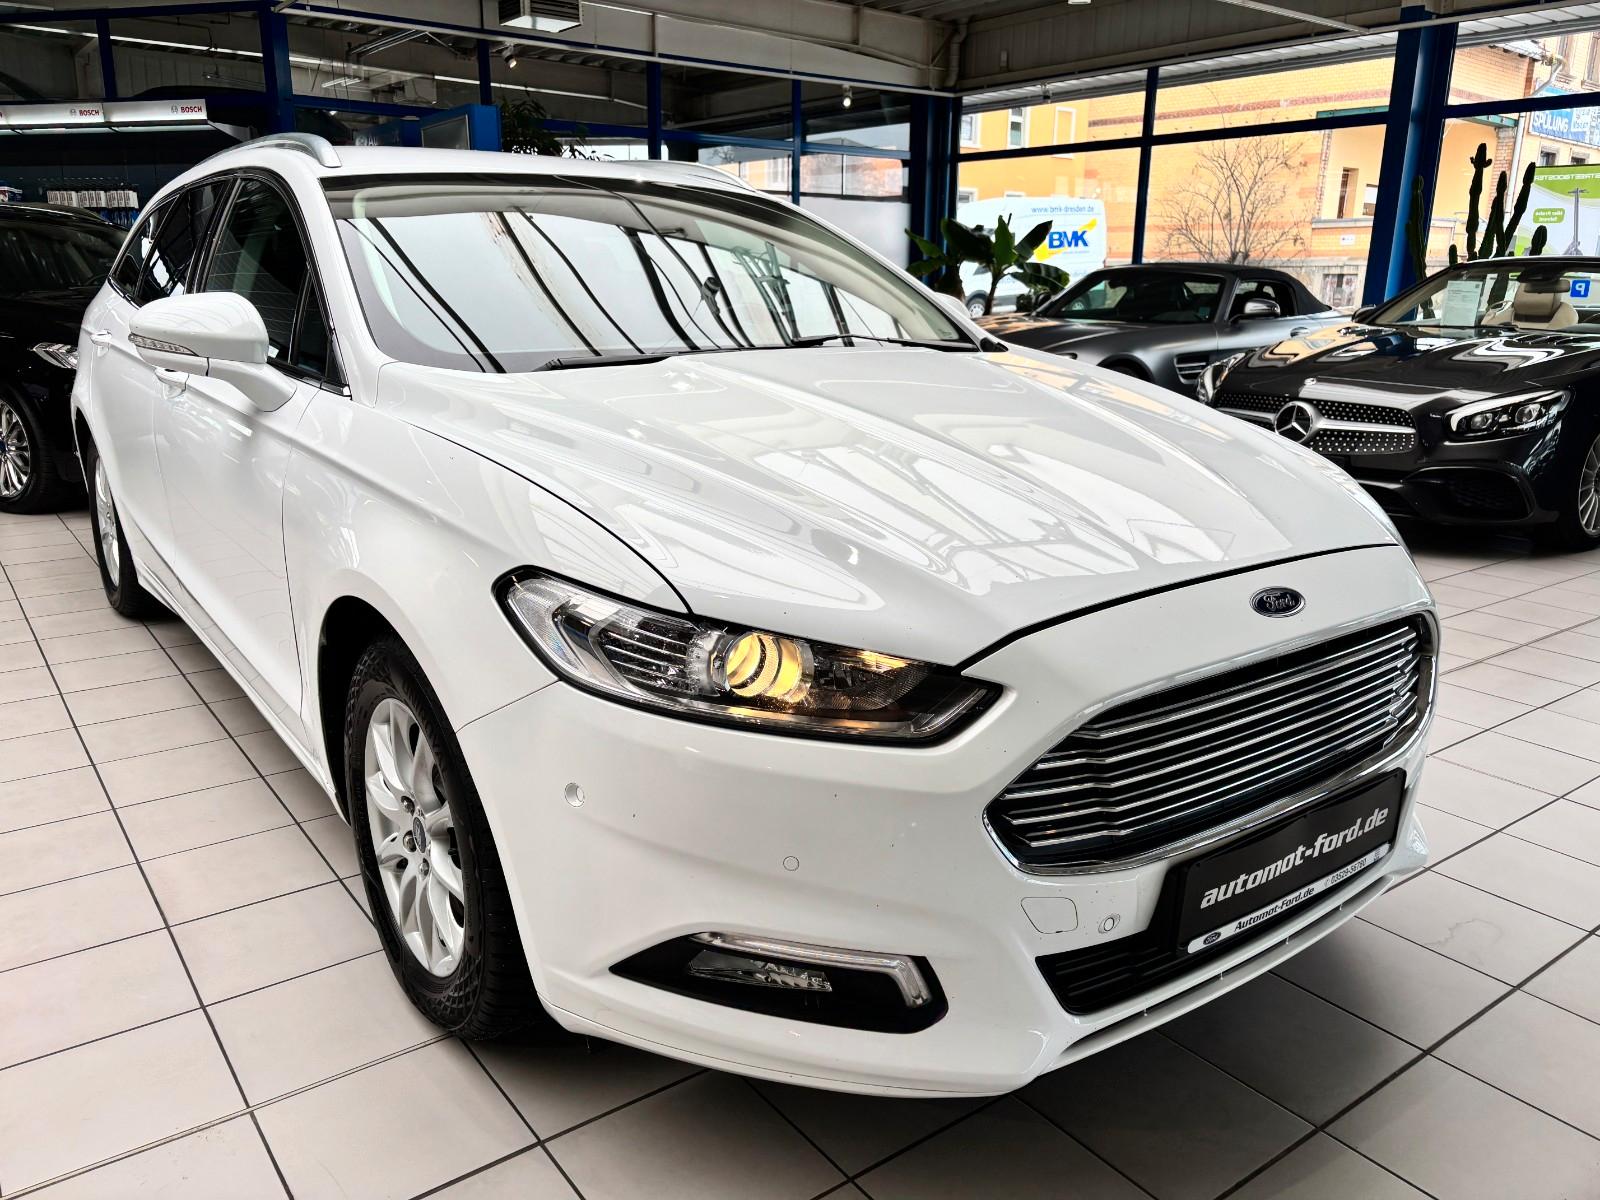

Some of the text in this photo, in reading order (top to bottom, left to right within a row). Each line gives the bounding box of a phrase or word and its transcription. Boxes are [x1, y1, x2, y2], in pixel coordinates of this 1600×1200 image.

[79, 109, 100, 117] BOSCH
[180, 105, 203, 114] BOSCH
[1048, 230, 1089, 249] BMK
[1200, 807, 1389, 909] automot-ford.de
[1234, 886, 1315, 932] Automot-Ford.de
